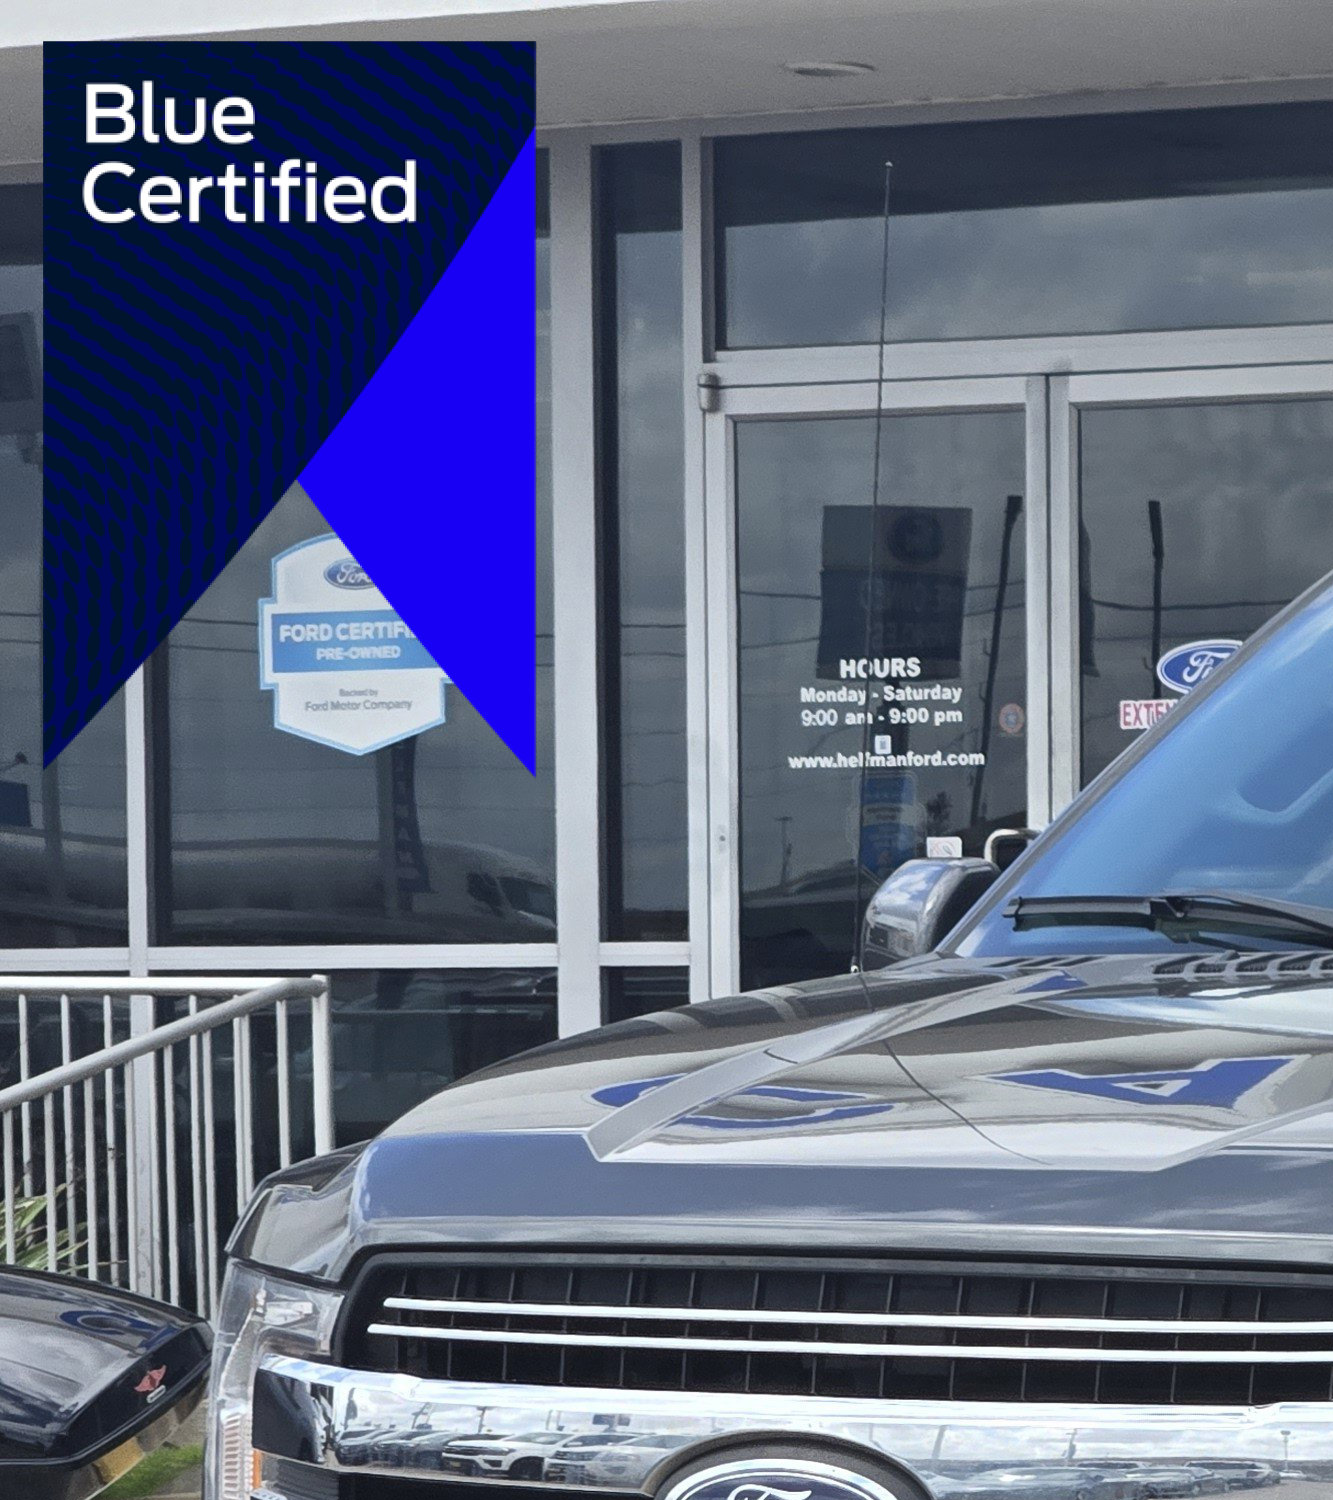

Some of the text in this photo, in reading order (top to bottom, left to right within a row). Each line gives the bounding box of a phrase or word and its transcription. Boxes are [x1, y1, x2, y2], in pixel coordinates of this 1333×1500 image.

[279, 624, 333, 643] FORD
[316, 645, 401, 660] PRE-OWNED
[839, 657, 921, 679] HOURS
[800, 685, 867, 706] Monday
[883, 684, 962, 704] Saturday
[305, 700, 412, 712] Ford Motor Company
[801, 708, 839, 727] 9:00
[845, 711, 873, 725] am
[889, 707, 929, 725] 9:00
[934, 709, 963, 726] pm
[788, 750, 985, 769] www.helfmanford.com
